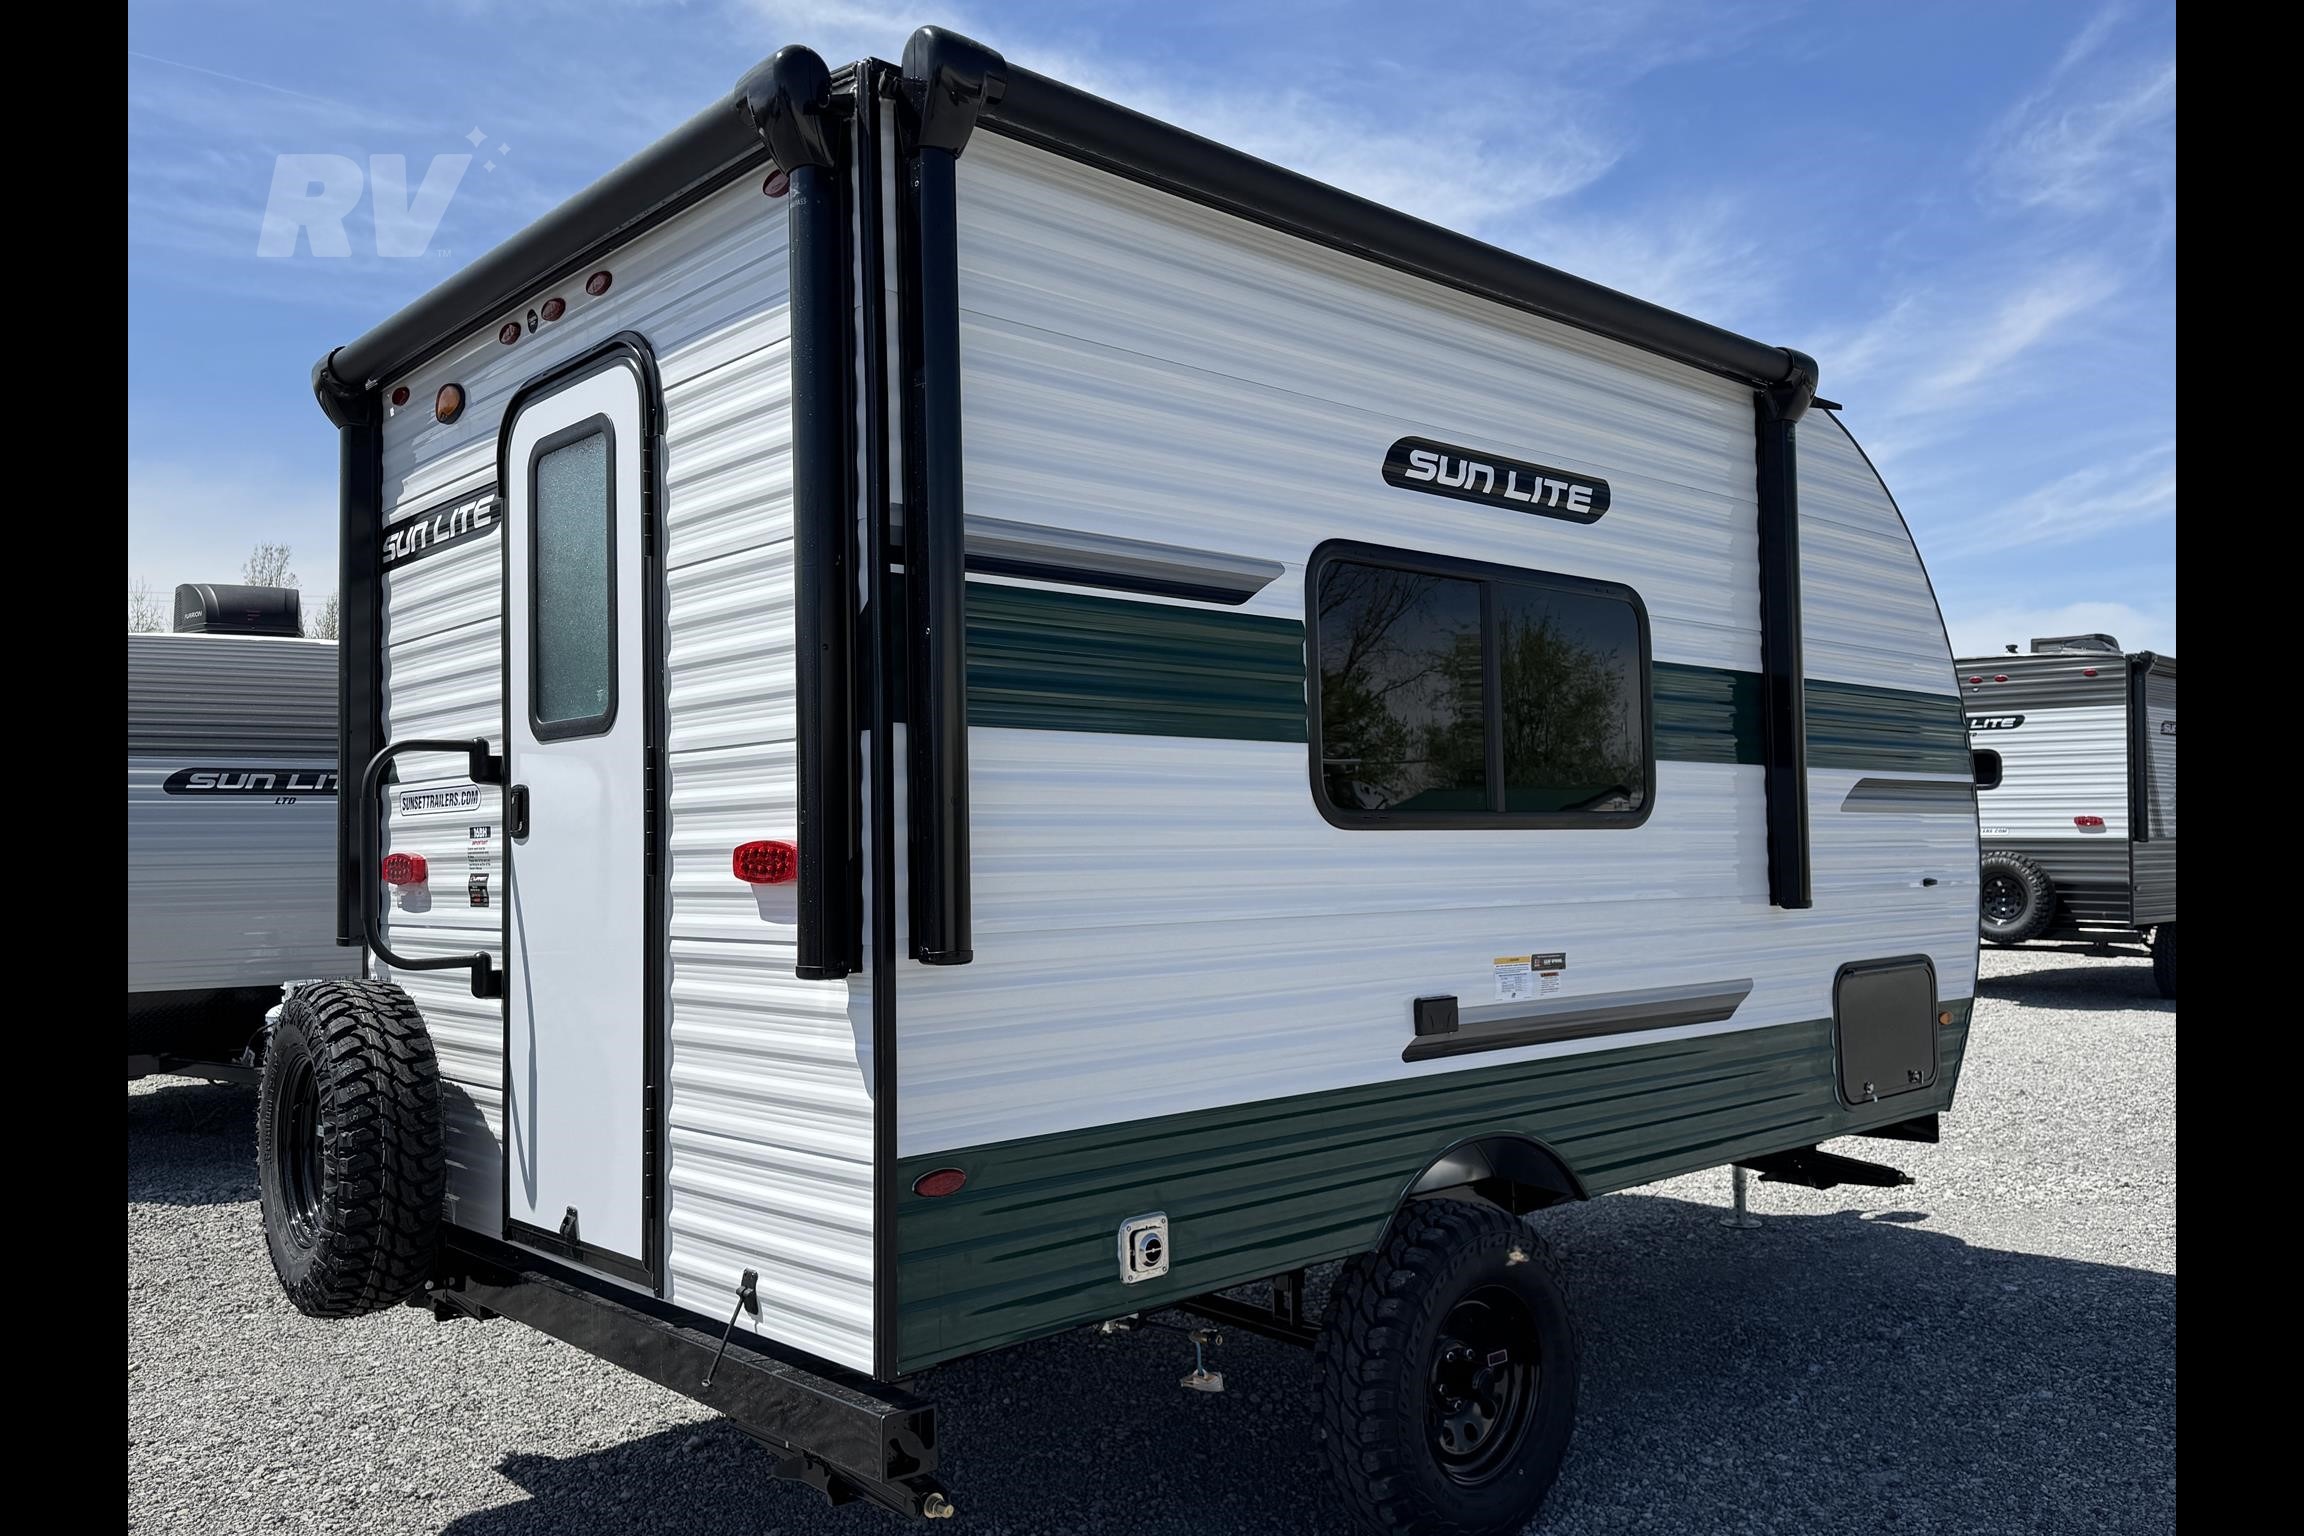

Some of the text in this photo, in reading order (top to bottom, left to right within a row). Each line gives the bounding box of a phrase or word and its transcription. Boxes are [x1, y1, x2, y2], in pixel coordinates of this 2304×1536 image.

[1405, 450, 1593, 514] SUN LITE
[383, 494, 495, 561] SUN LITE
[1970, 718, 2016, 728] LITE
[186, 773, 338, 789] SUN LIT
[275, 797, 297, 805] LTD
[402, 789, 479, 811] SUNSETTRAILERS.COM
